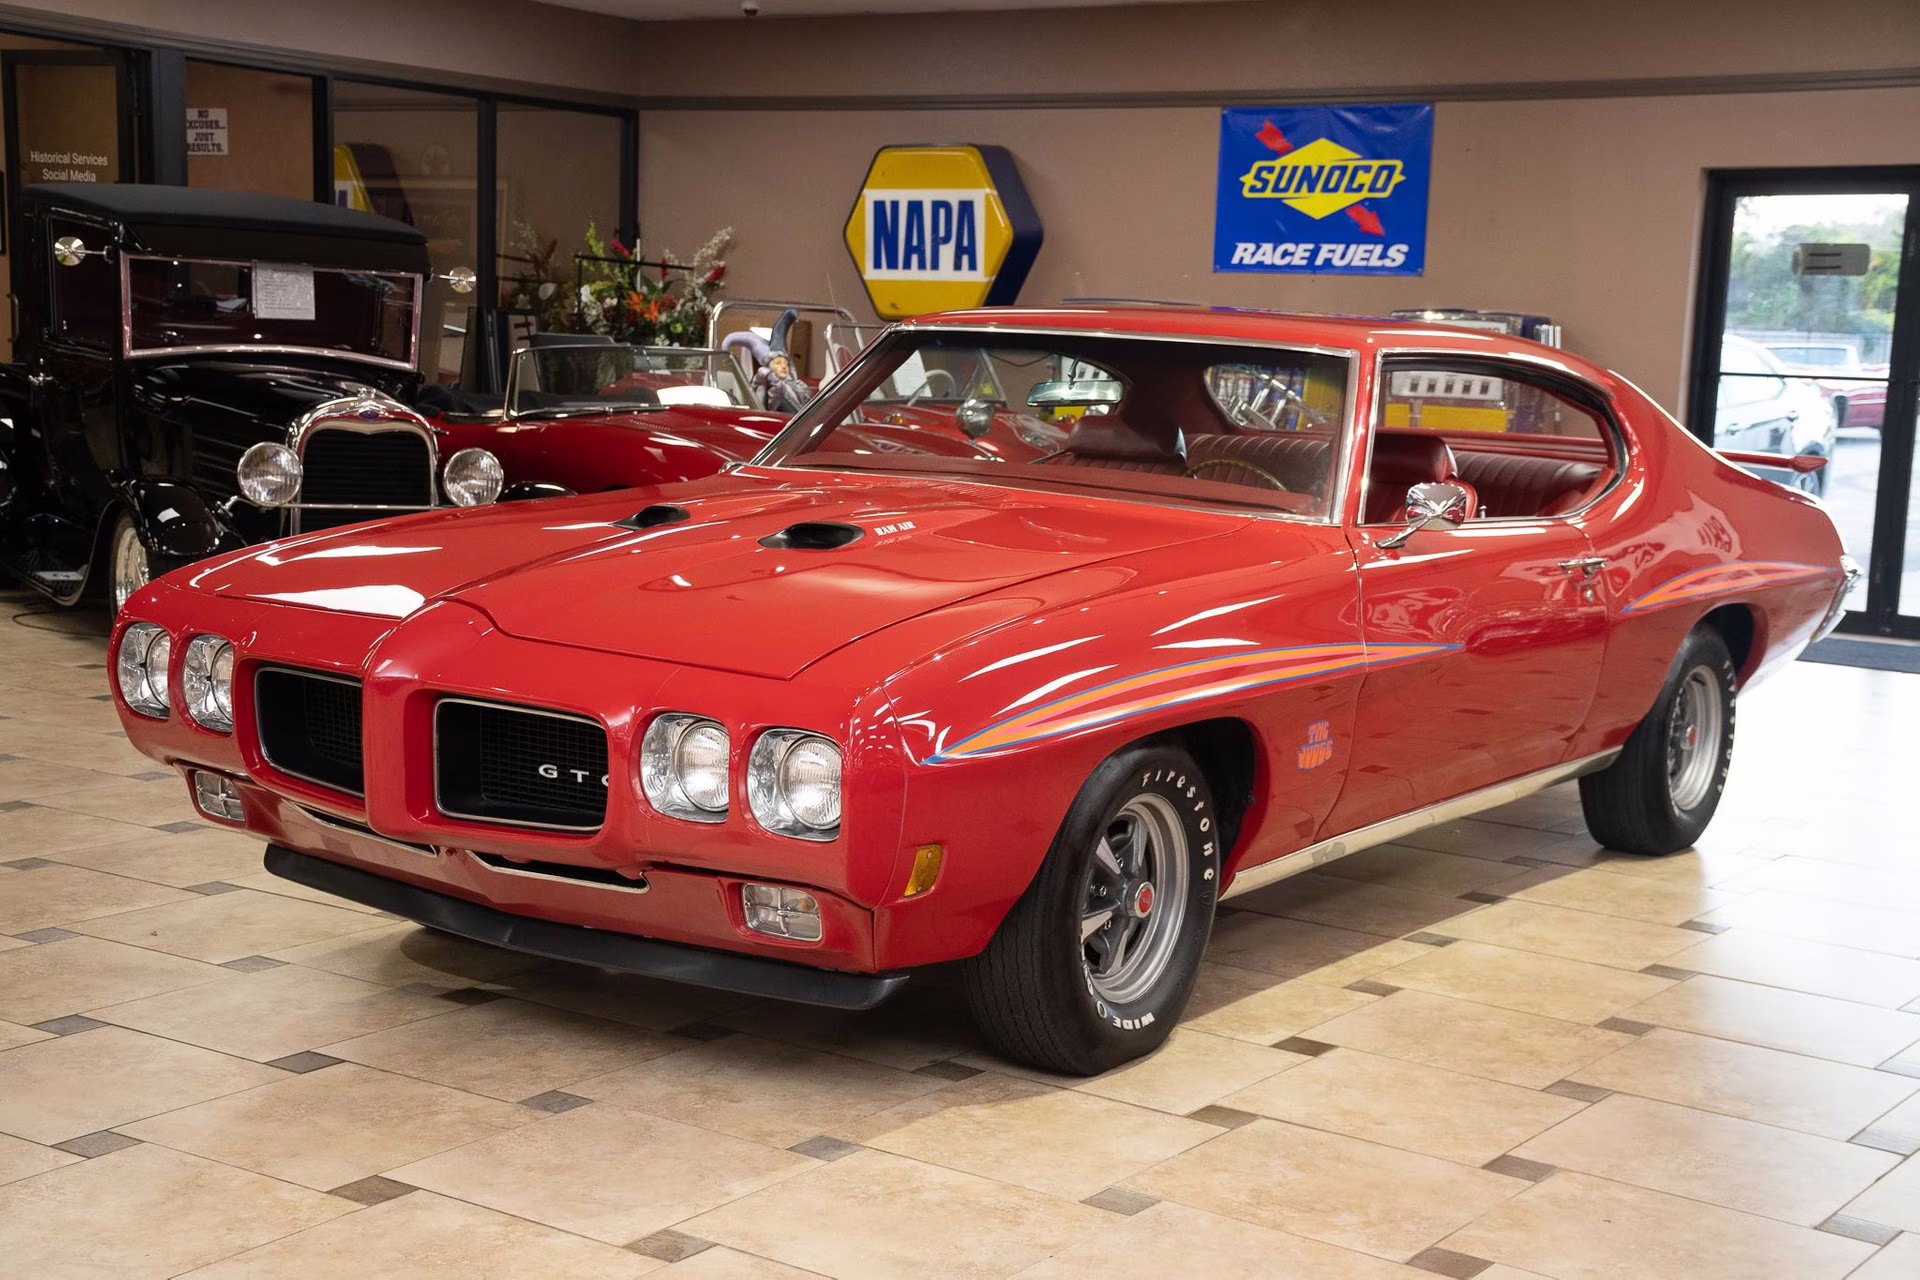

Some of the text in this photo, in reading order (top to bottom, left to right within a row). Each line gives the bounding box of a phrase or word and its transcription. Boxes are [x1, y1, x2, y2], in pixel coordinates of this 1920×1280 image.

[187, 120, 226, 130] XCUSES...
[30, 150, 108, 166] Historical Services
[42, 168, 97, 183] Social Media
[1248, 164, 1397, 193] SUNOCO
[873, 199, 977, 271] NAPA
[1231, 242, 1409, 268] RACE FUELS
[1112, 1012, 1155, 1030] WIDE
